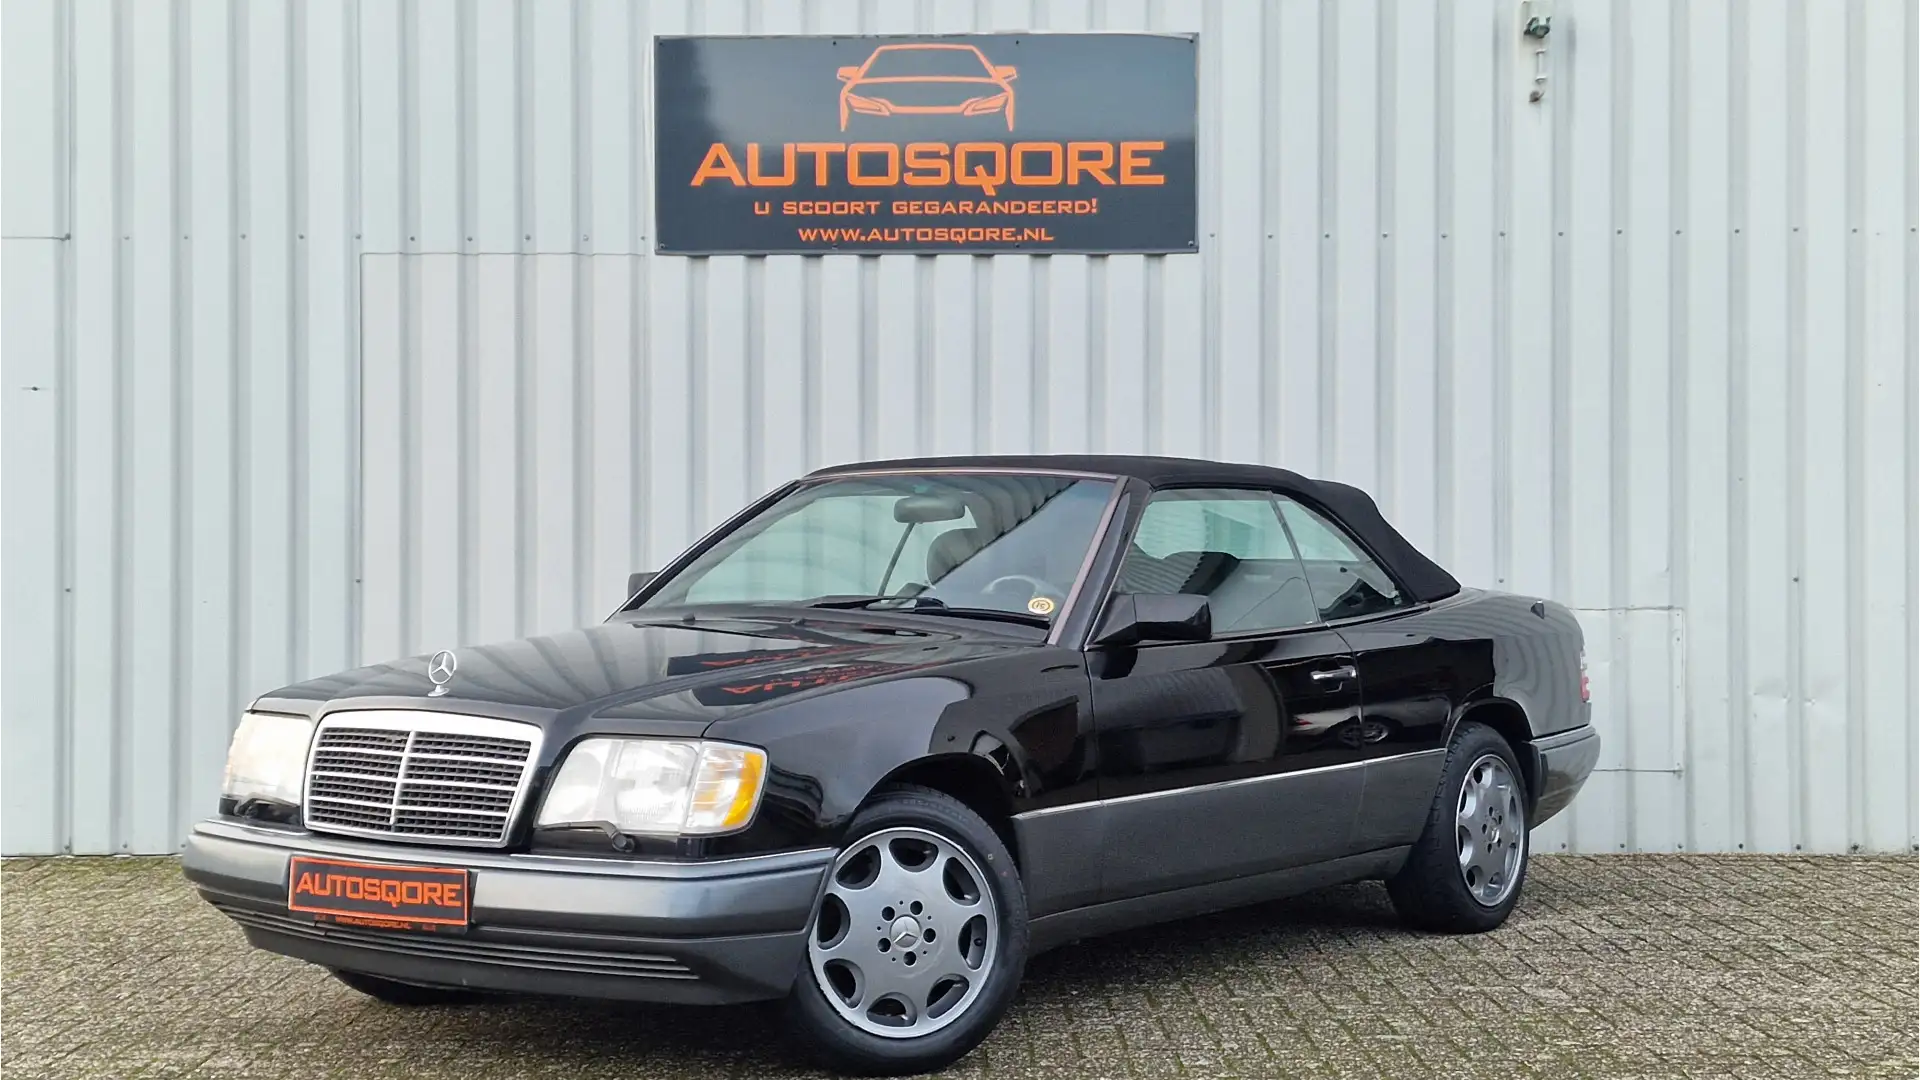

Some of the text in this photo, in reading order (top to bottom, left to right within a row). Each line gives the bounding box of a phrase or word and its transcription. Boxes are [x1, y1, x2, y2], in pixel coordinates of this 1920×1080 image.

[691, 141, 1166, 196] AUTOSQORE
[754, 198, 1098, 215] U SCOORT GEGARANDEERD!
[798, 228, 1054, 243] WWW.AUTOSQORE.NL
[296, 872, 461, 908] AUTOSQORE
